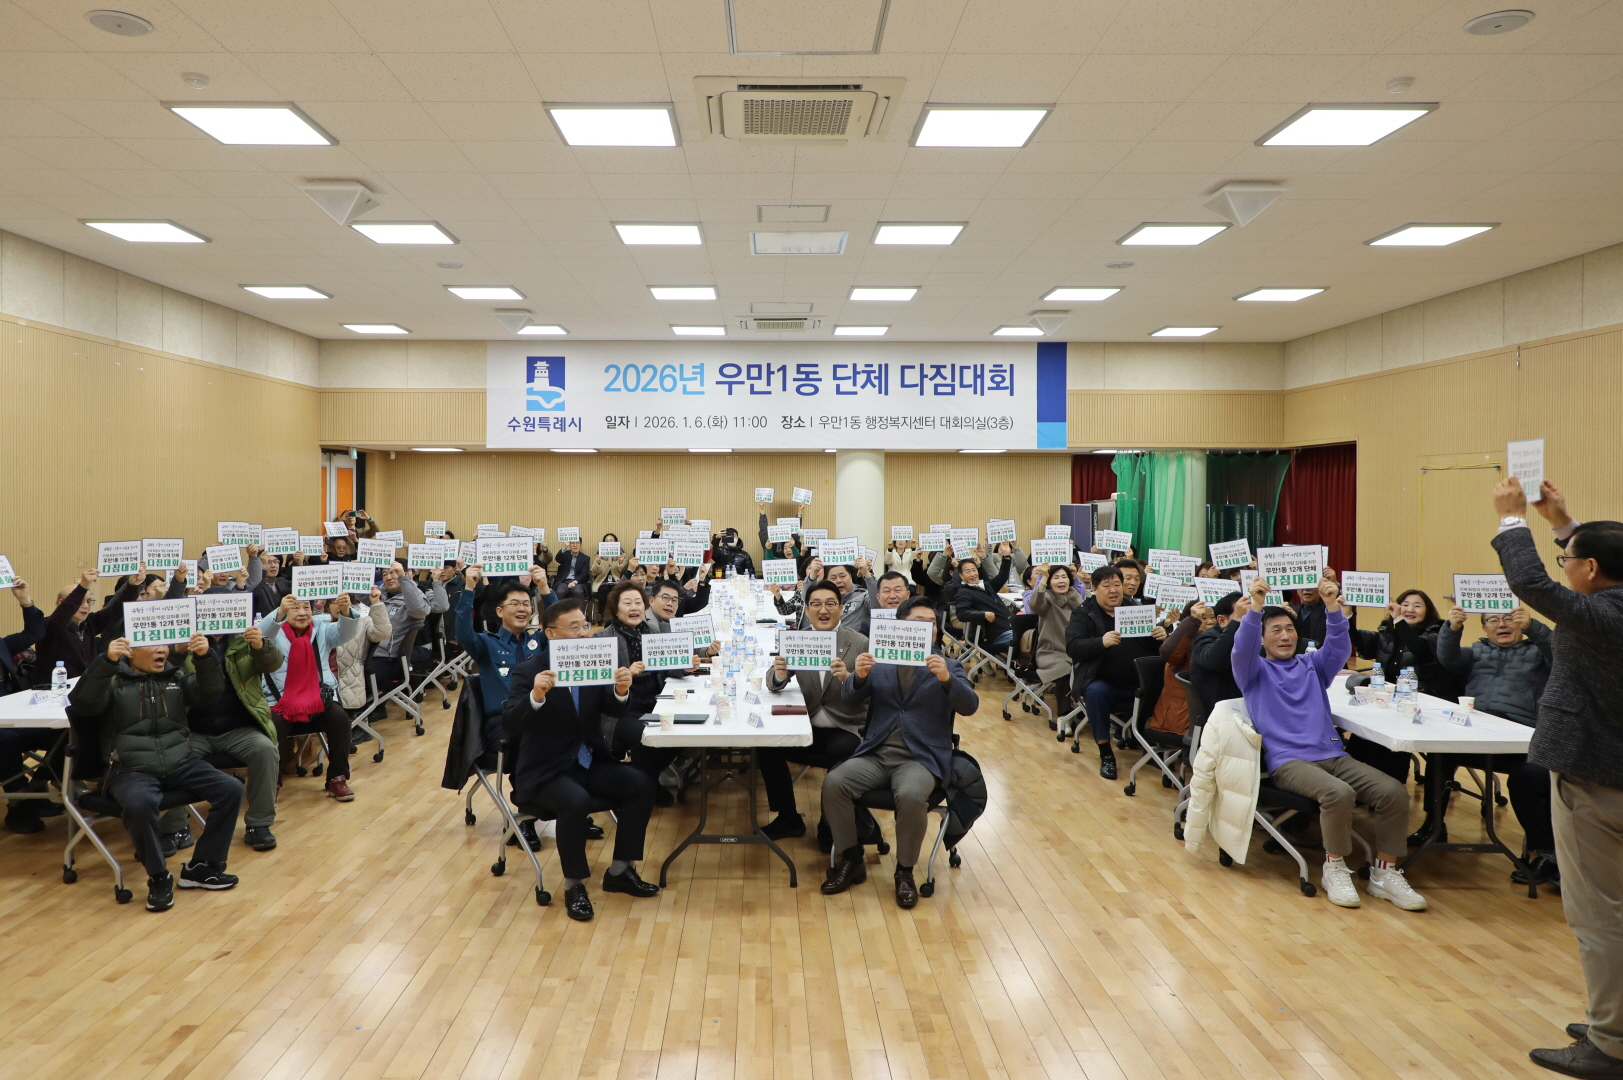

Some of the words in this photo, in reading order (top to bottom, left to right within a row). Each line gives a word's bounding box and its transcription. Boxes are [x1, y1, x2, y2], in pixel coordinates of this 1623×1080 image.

[604, 363, 705, 395] 2026년
[716, 363, 822, 396] 우만1동
[832, 363, 889, 396] 단체
[900, 363, 1014, 396] 다짐대회
[507, 416, 581, 432] 수원특례시
[605, 416, 630, 429] 일자
[734, 416, 767, 428] 11:00
[781, 416, 806, 429] 장소
[818, 416, 861, 430] 우만1동
[866, 416, 935, 430] 행정복지센터
[940, 415, 1014, 430] 대회의실(3층)
[103, 563, 136, 573] 다짐대회
[483, 562, 528, 573] 다짐대회
[1265, 573, 1317, 586] 다짐대회
[297, 586, 338, 597] 다짐대회
[1347, 593, 1385, 604] 다짐대회
[1462, 599, 1513, 609] 다짐대회
[132, 621, 157, 629] 우만1동
[197, 619, 247, 631] 다짐대회
[132, 627, 190, 642] 다짐대회
[695, 636, 711, 644] 대회
[875, 647, 926, 661] 다짐대회
[648, 656, 689, 666] 다짐대회
[785, 656, 831, 666] 다짐대회
[557, 668, 612, 682] 다짐대회
